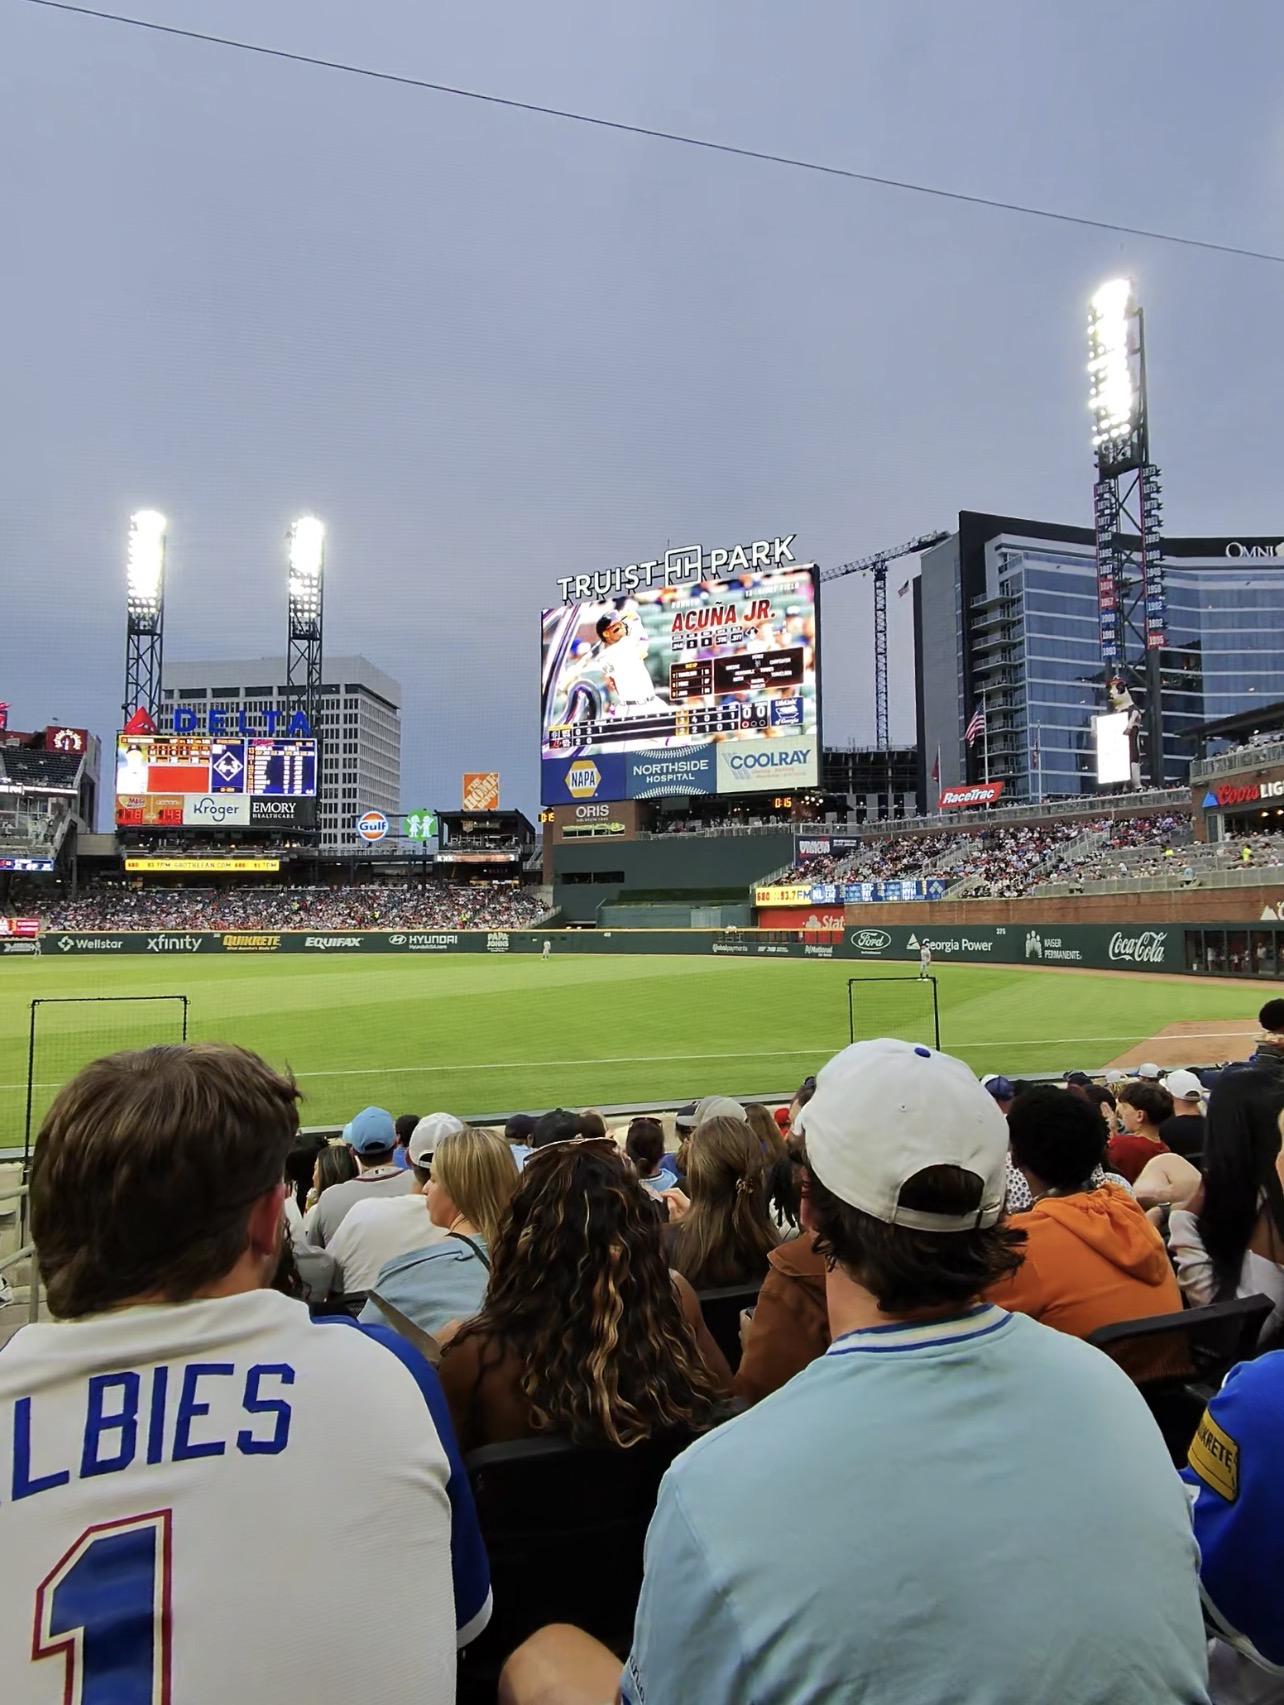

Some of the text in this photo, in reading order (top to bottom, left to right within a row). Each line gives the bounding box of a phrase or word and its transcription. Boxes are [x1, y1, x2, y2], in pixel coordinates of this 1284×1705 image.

[557, 535, 798, 600] TRUIST PARK
[671, 599, 776, 633] ACUÑA JR.
[743, 707, 752, 719] 0
[757, 704, 766, 717] 0
[173, 708, 312, 737] DELTA
[730, 749, 811, 770] COOLRAY
[633, 759, 709, 776] NORTHSIDE
[571, 770, 596, 788] NAPA
[646, 772, 696, 783] HOSPITAL
[464, 772, 499, 810] HOME
[942, 789, 995, 804] RaceTrac
[1217, 780, 1284, 806] Coors LIG
[163, 808, 181, 820] 143
[194, 797, 239, 822] Kroger
[253, 802, 297, 813] EMORY
[575, 804, 610, 818] ORIS
[359, 821, 387, 831] Gulf
[757, 891, 770, 902] 680
[822, 915, 845, 929] Stat
[76, 939, 123, 949] Wellstar
[147, 934, 202, 952] xfinity
[222, 935, 281, 947] QUIKRETE
[304, 936, 361, 950] EQUIFAX
[409, 935, 458, 945] HYUNDAI
[857, 931, 884, 948] Ford
[922, 938, 993, 953] Georgia Power
[1044, 938, 1062, 948] KAISER
[1044, 949, 1080, 960] PERMANENTE
[31, 1508, 173, 1705] 1
